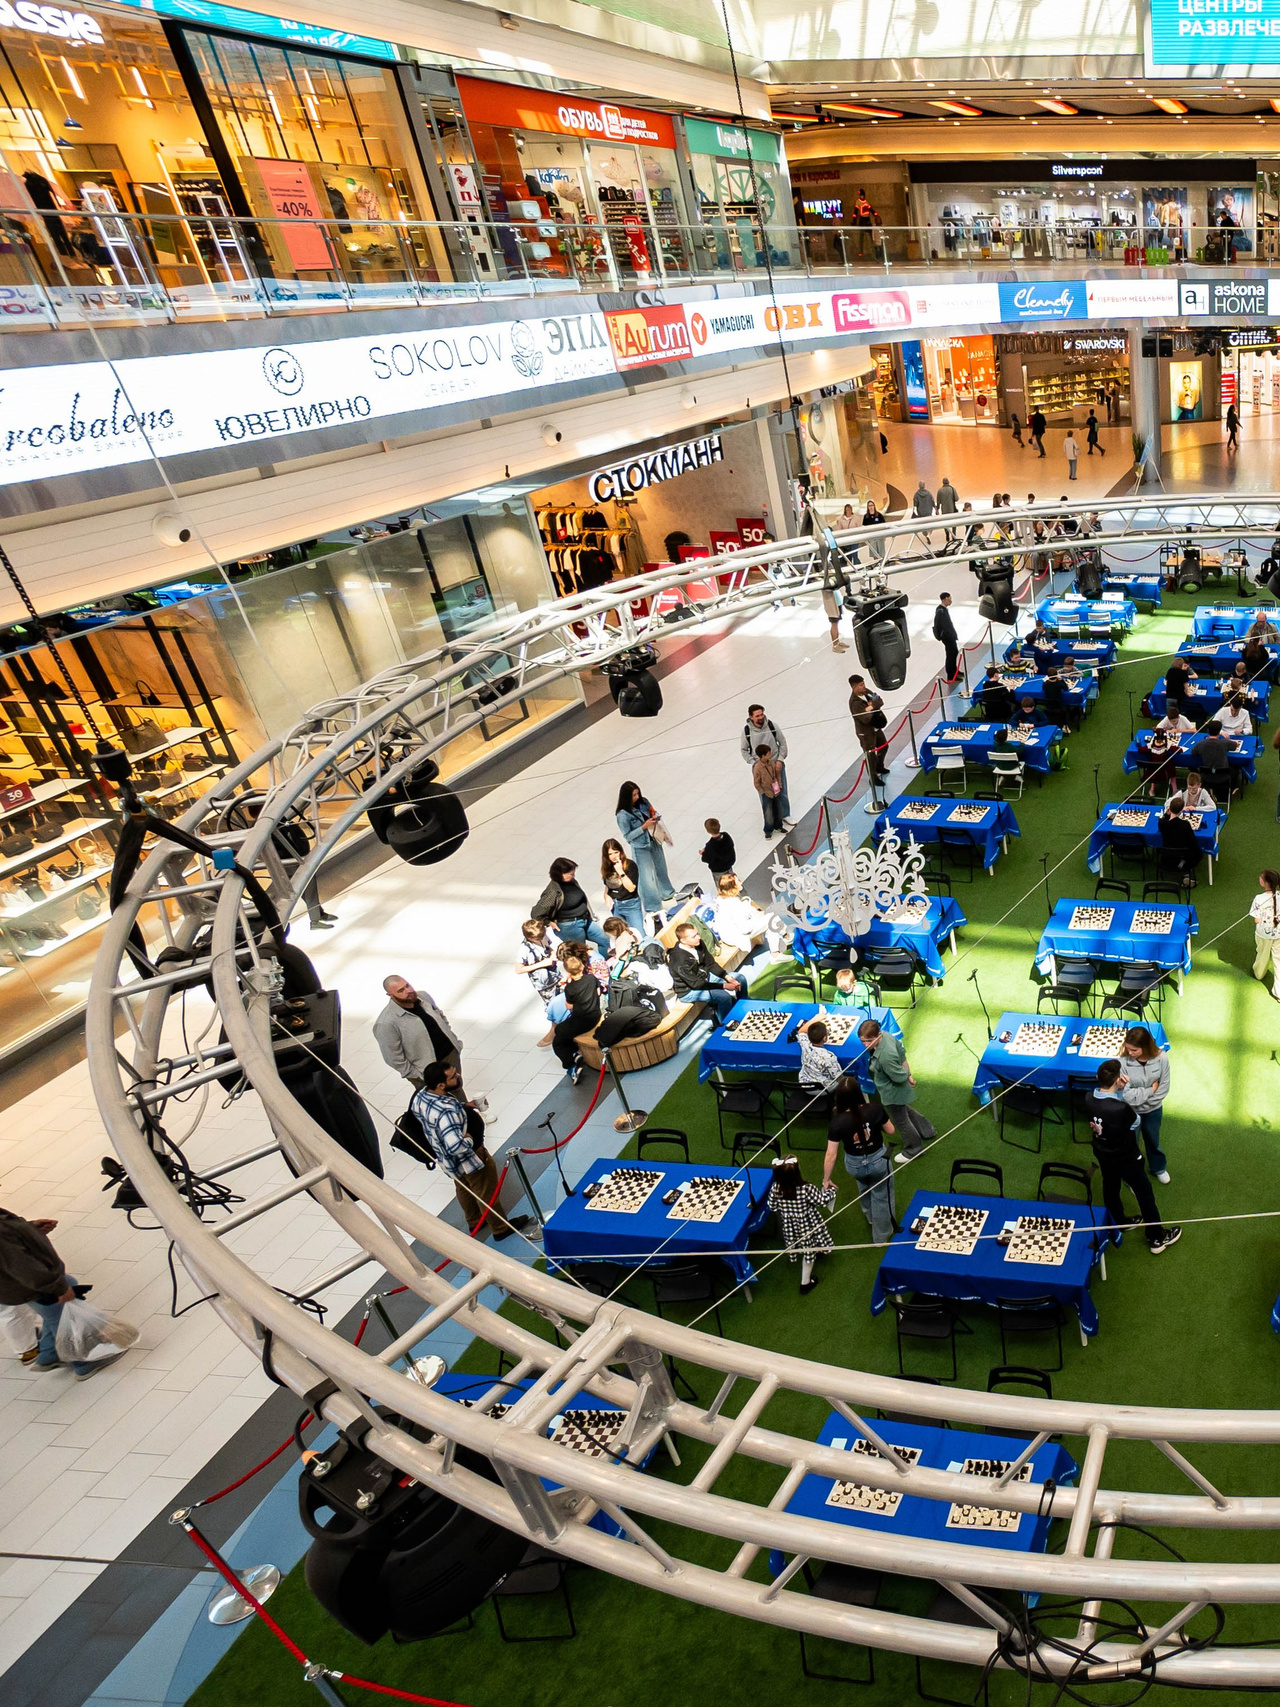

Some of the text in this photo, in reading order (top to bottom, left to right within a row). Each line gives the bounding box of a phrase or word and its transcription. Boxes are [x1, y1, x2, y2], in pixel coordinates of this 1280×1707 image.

[1178, 0, 1263, 16] ЦЕНТРЫ
[558, 106, 603, 132] ОБУВЬ
[277, 201, 313, 217] -40%
[1214, 282, 1265, 296] askona
[764, 303, 823, 331] OBI
[838, 298, 906, 326] fissman
[1214, 297, 1265, 314] HOME
[542, 314, 607, 356] ЭПЛ
[709, 314, 755, 335] YAMAGUCHI
[625, 322, 690, 356] Aurum
[1075, 339, 1125, 349] SWAROVSKI
[368, 333, 501, 380] SOKOLOV
[0, 386, 174, 451] rcobaleno
[215, 395, 371, 441] ЮВЕЛИРНО
[588, 434, 725, 503] СТОКМАНН
